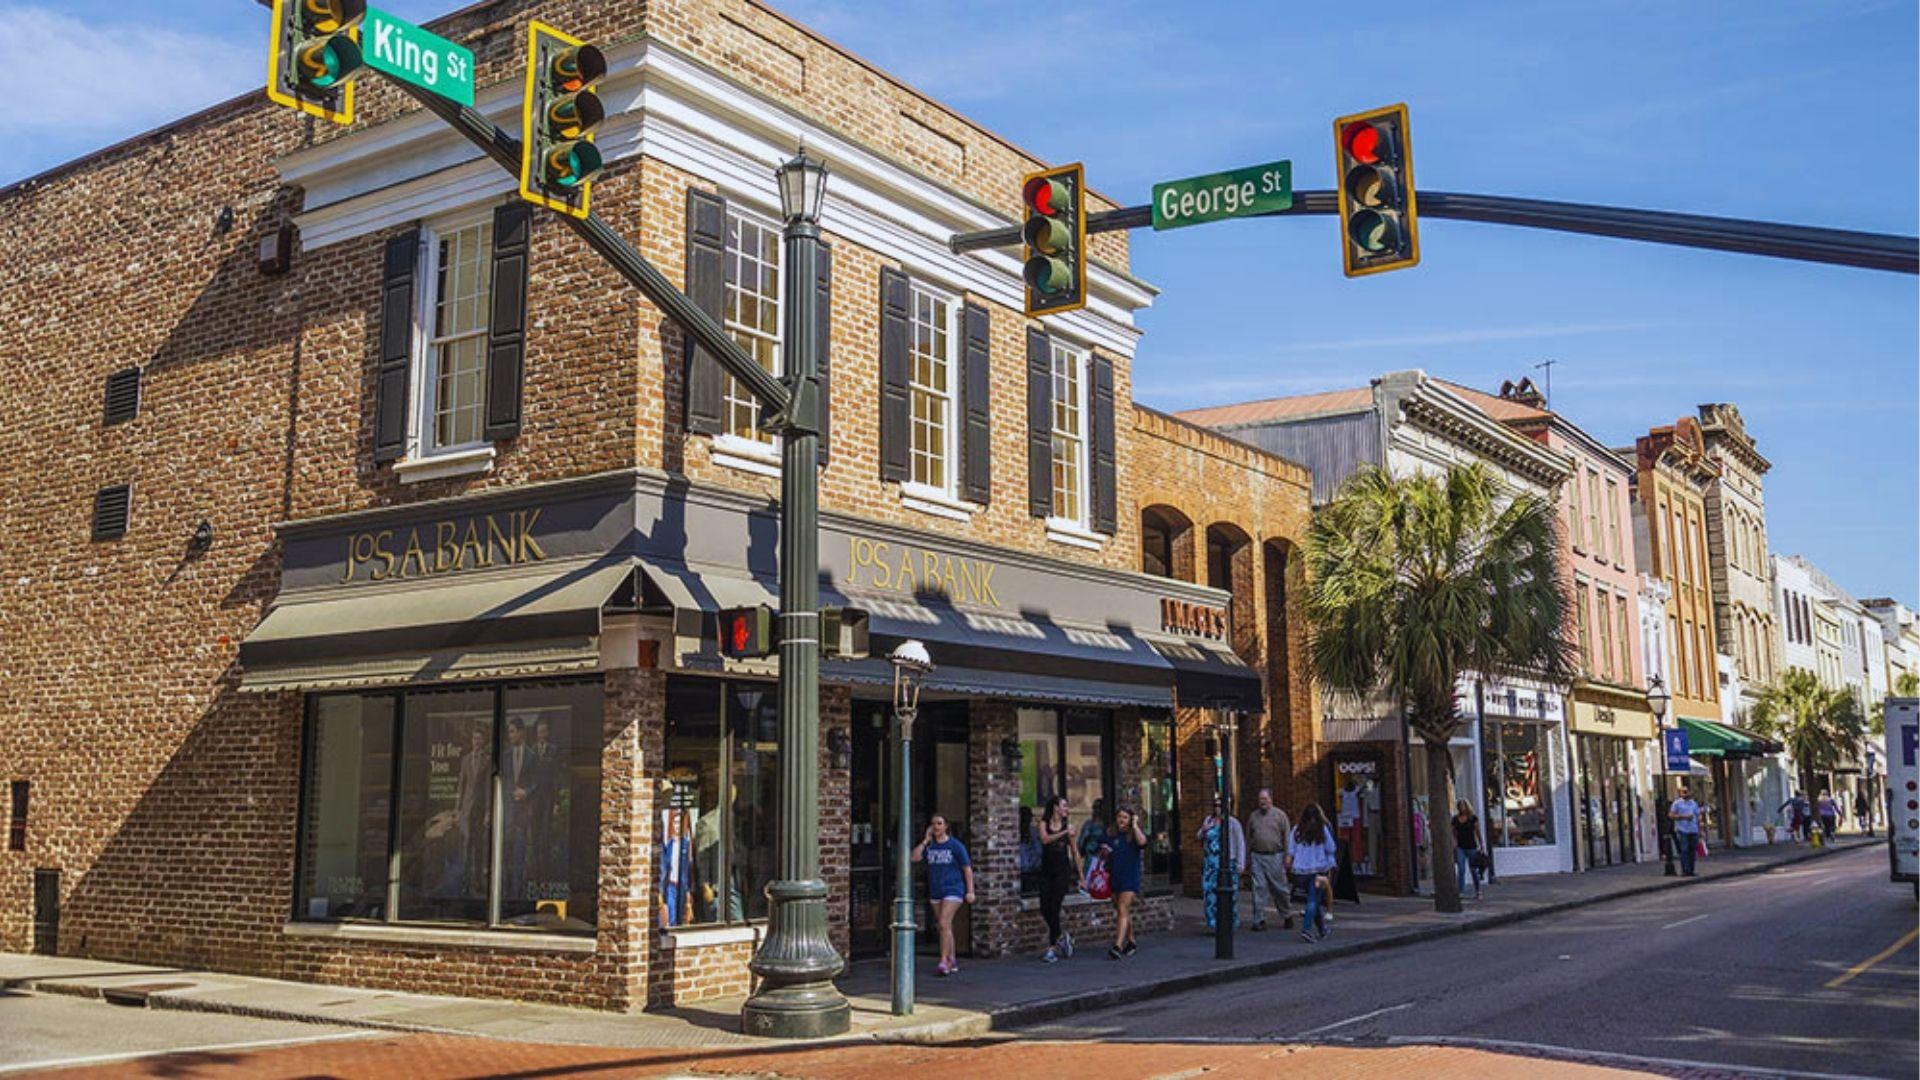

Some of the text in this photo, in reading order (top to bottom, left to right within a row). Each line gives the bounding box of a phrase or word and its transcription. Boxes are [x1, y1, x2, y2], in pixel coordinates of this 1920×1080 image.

[374, 19, 467, 85] King St
[1161, 170, 1282, 220] George St
[434, 508, 546, 572] BANK
[922, 551, 1000, 607] BANK
